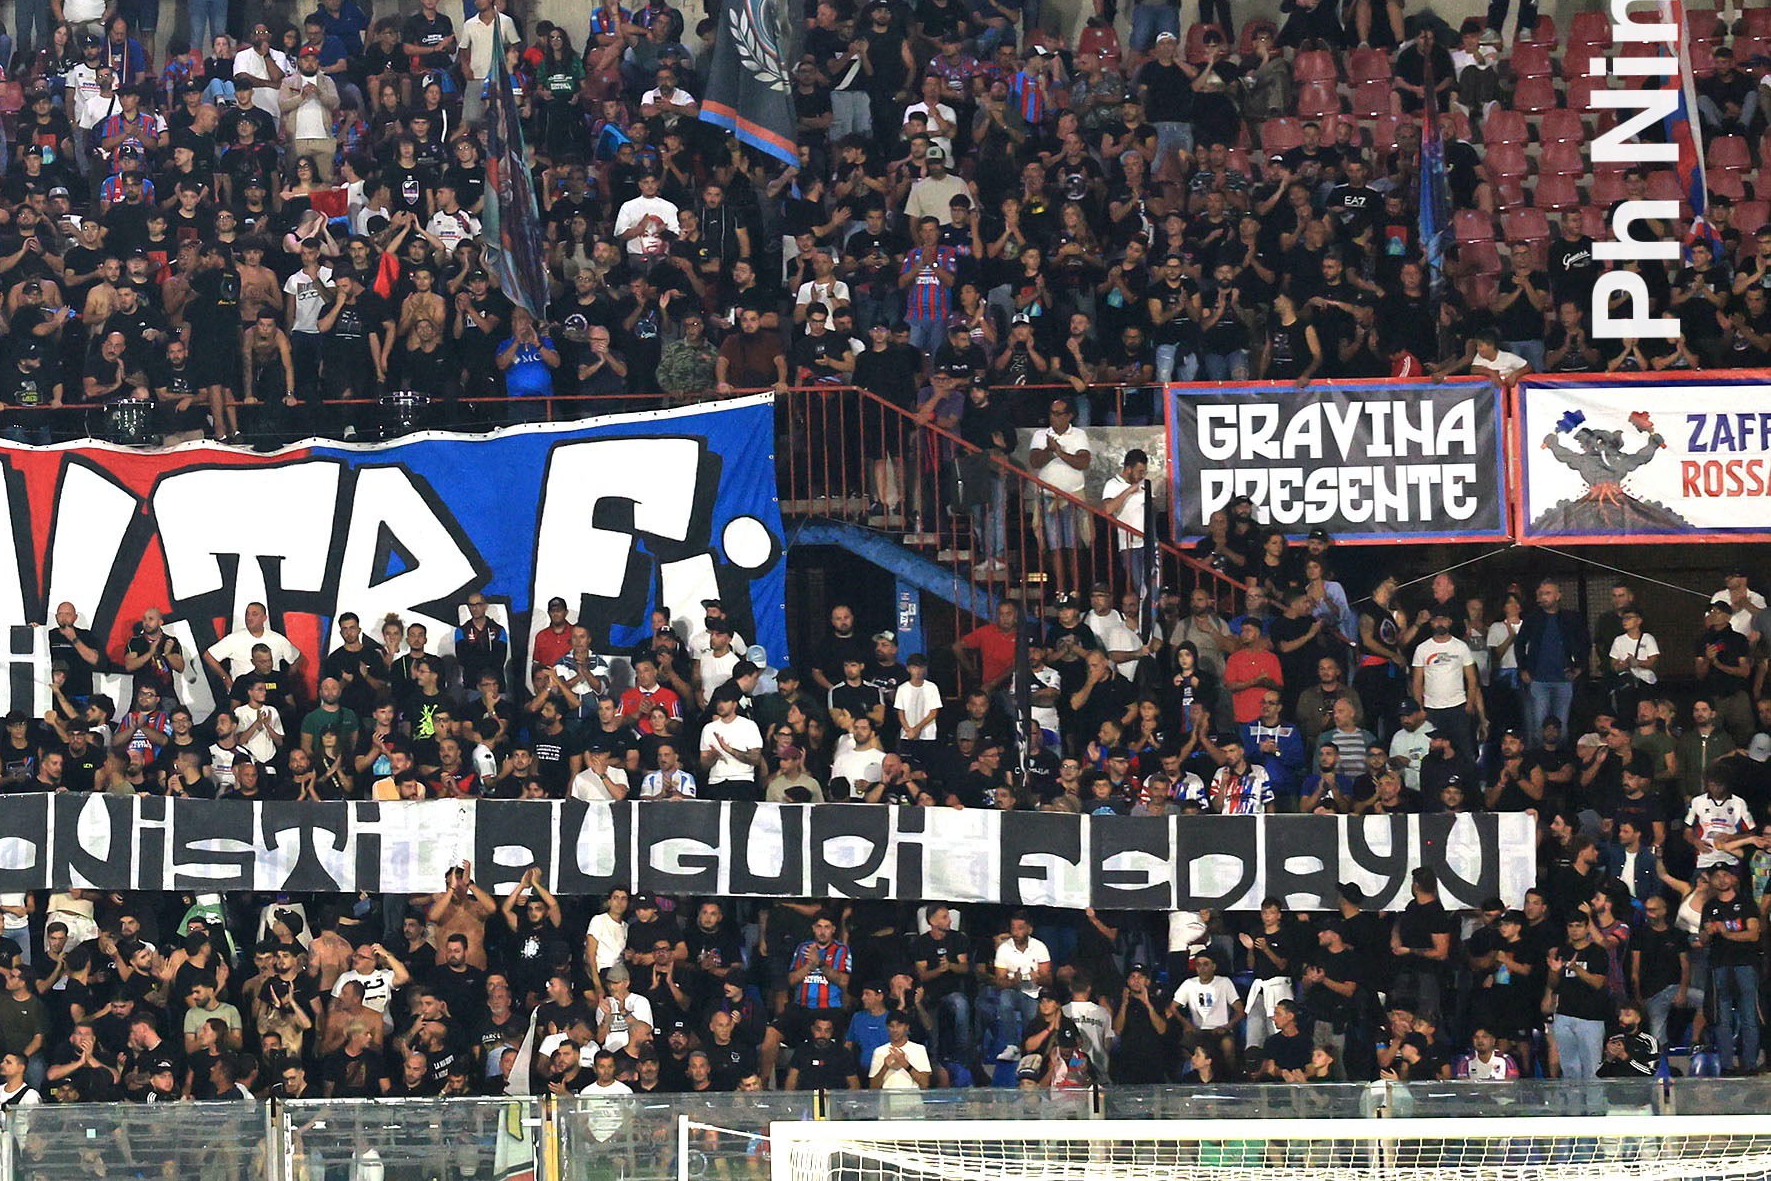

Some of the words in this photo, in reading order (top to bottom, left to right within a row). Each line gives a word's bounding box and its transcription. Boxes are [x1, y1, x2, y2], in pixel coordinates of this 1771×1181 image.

[1344, 195, 1366, 205] EA7
[1196, 398, 1477, 462] GRAVINA
[1200, 463, 1478, 525] PRESENTE
[1680, 460, 1771, 497] ROSS
